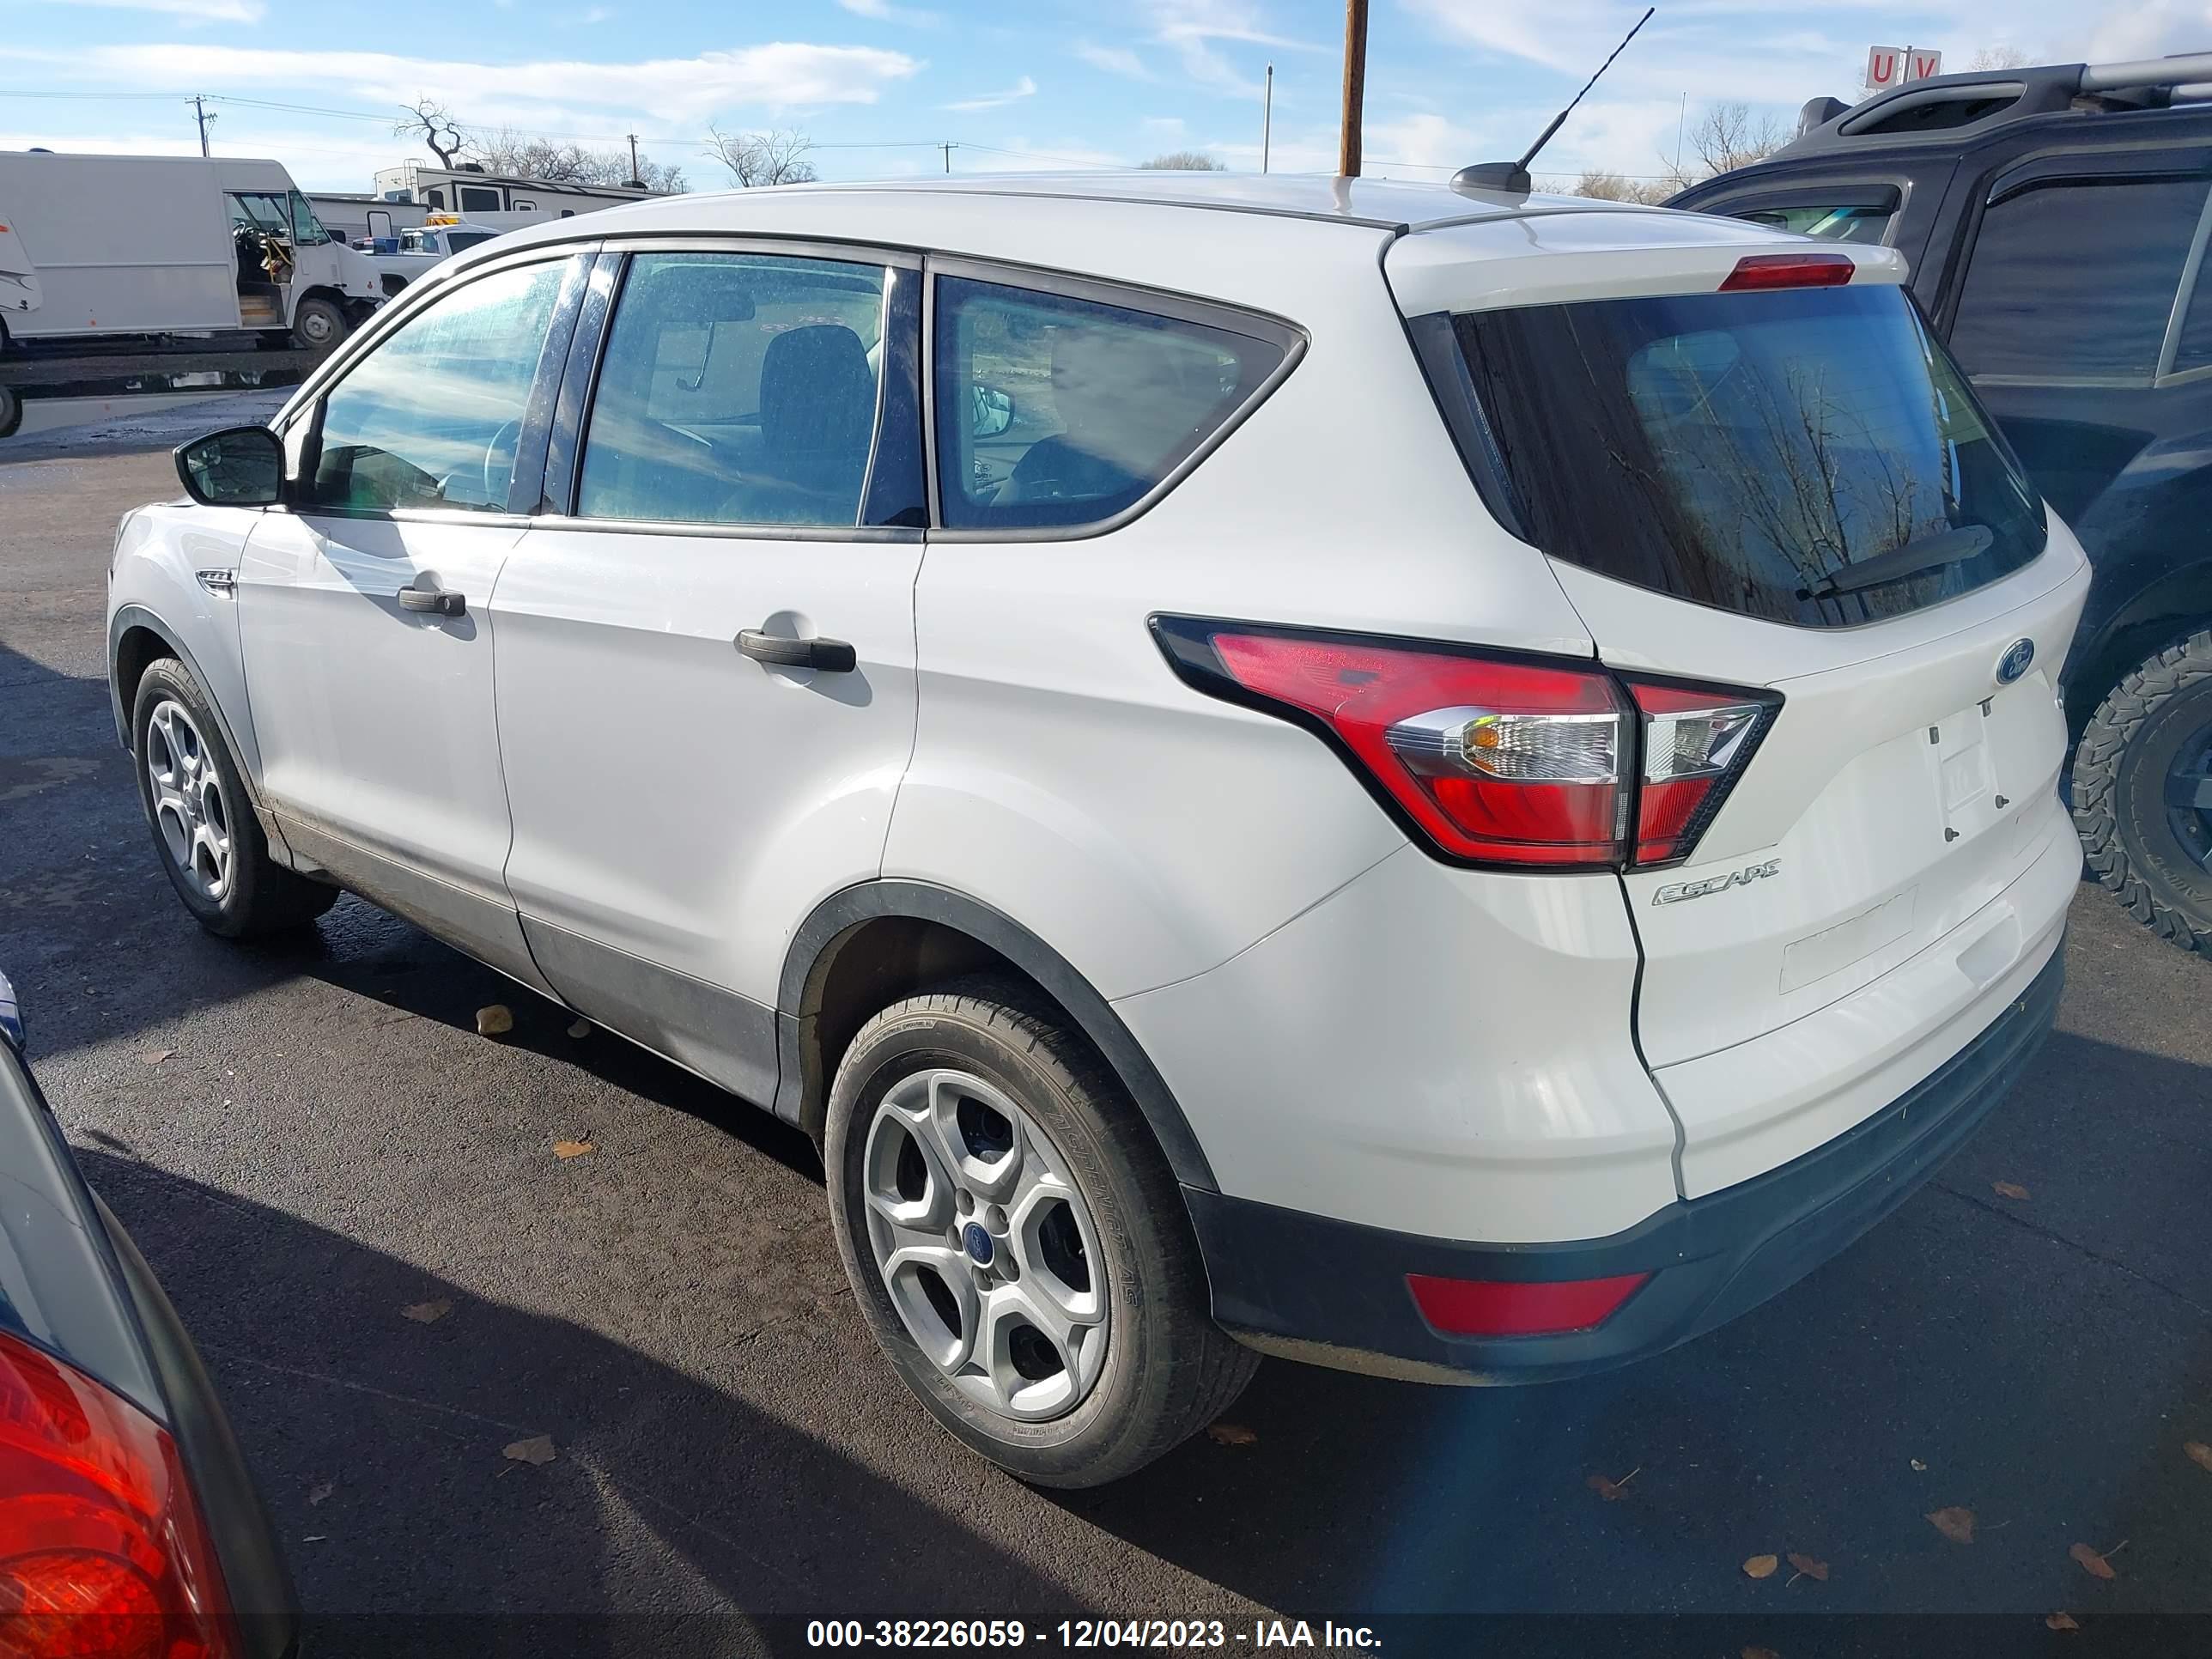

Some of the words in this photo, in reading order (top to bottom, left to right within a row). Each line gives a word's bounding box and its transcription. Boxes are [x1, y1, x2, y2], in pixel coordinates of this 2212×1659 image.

[1873, 54, 1894, 83] U
[1917, 57, 1936, 79] V
[1650, 858, 1783, 907] ESCAPE
